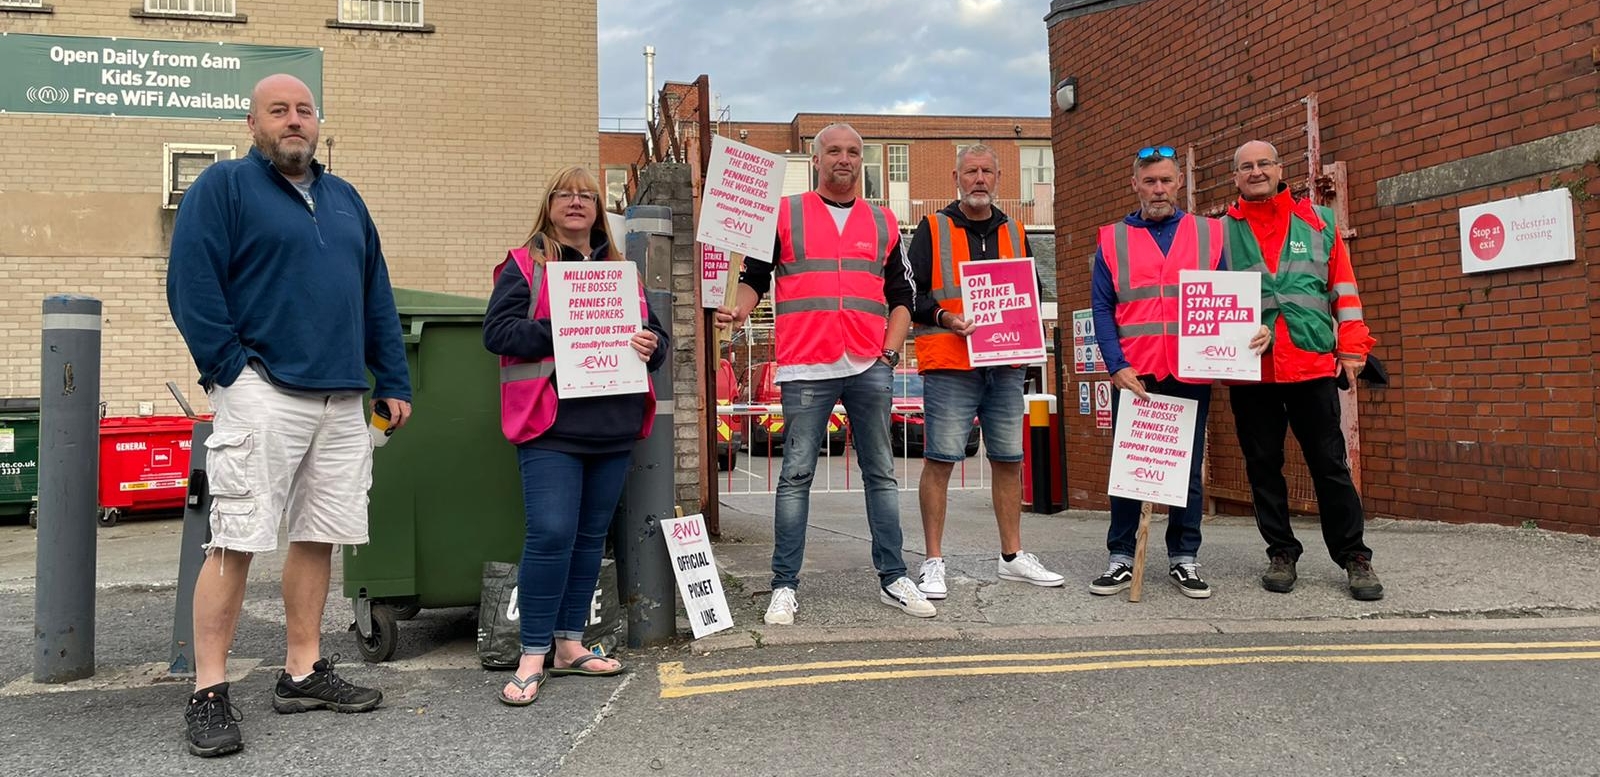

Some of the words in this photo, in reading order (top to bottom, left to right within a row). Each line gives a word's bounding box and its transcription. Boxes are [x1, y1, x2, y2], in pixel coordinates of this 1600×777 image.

[50, 46, 98, 64] Open
[103, 48, 149, 68] Daily
[152, 50, 198, 68] from
[201, 52, 240, 70] 6am
[102, 69, 143, 86] Kids
[146, 71, 191, 88] Zone
[74, 88, 118, 106] Free
[120, 90, 163, 108] WiFi
[166, 92, 251, 110] Available
[724, 146, 760, 164] MILLIONS
[760, 158, 774, 168] FOR
[728, 158, 742, 168] THE
[743, 162, 767, 176] BOSSES
[723, 169, 754, 184] PENNIES
[754, 178, 768, 189] FOR
[721, 178, 734, 188] THE
[735, 182, 768, 199] WORKERS
[710, 188, 738, 202] SUPPORT
[738, 197, 752, 208] OUR
[753, 200, 775, 214] STRIKE
[716, 202, 765, 222] #StandByYourPost
[718, 217, 753, 234] CWU
[1511, 216, 1556, 231] Pedestrian
[1472, 227, 1490, 239] Stop
[1492, 226, 1500, 234] at
[1516, 228, 1552, 241] crossing
[1480, 240, 1495, 250] exit
[704, 262, 715, 270] FOR
[564, 270, 605, 280] MILLIONS
[607, 270, 622, 279] FOR
[968, 276, 986, 288] ON
[572, 283, 586, 292] THE
[588, 282, 617, 292] BOSSES
[970, 286, 1010, 300] STRIKE
[1186, 285, 1207, 295] ON
[569, 298, 605, 308] PENNIES
[607, 298, 622, 306] FOR
[972, 301, 995, 312] FOR
[999, 296, 1026, 308] FAIR
[1186, 297, 1232, 308] STRIKE
[570, 310, 584, 320] THE
[586, 309, 624, 319] WORKERS
[974, 312, 997, 324] PAY
[1187, 310, 1214, 321] FOR
[1217, 310, 1248, 320] FAIR
[559, 328, 593, 336] SUPPORT
[594, 326, 610, 335] OUR
[611, 325, 637, 334] STRIKE
[1188, 324, 1215, 334] PAY
[987, 331, 1020, 344] CWU
[570, 340, 628, 350] #StandByYourPost
[1202, 346, 1236, 357] CWU
[579, 355, 618, 369] CWU
[1132, 398, 1168, 410] MILLIONS
[1170, 403, 1184, 413] FOR
[1137, 409, 1150, 418] THE
[1151, 410, 1177, 422] BOSSES
[1132, 420, 1164, 431] PENNIES
[1165, 425, 1179, 434] FOR
[1130, 430, 1143, 438] THE
[1144, 432, 1178, 444] WORKERS
[116, 442, 147, 451] GENERAL
[179, 440, 192, 448] WAS
[1119, 441, 1149, 451] SUPPORT
[1150, 446, 1164, 454] OUR
[1165, 449, 1188, 458] STRIKE
[0, 460, 36, 468] te.co.uk
[1126, 454, 1177, 467] #StandByYourPost
[1131, 467, 1164, 481] CWU
[672, 520, 700, 539] CWU
[677, 551, 710, 571] OFFICIAL
[688, 579, 714, 599] PICKET
[700, 608, 718, 626] LINE
